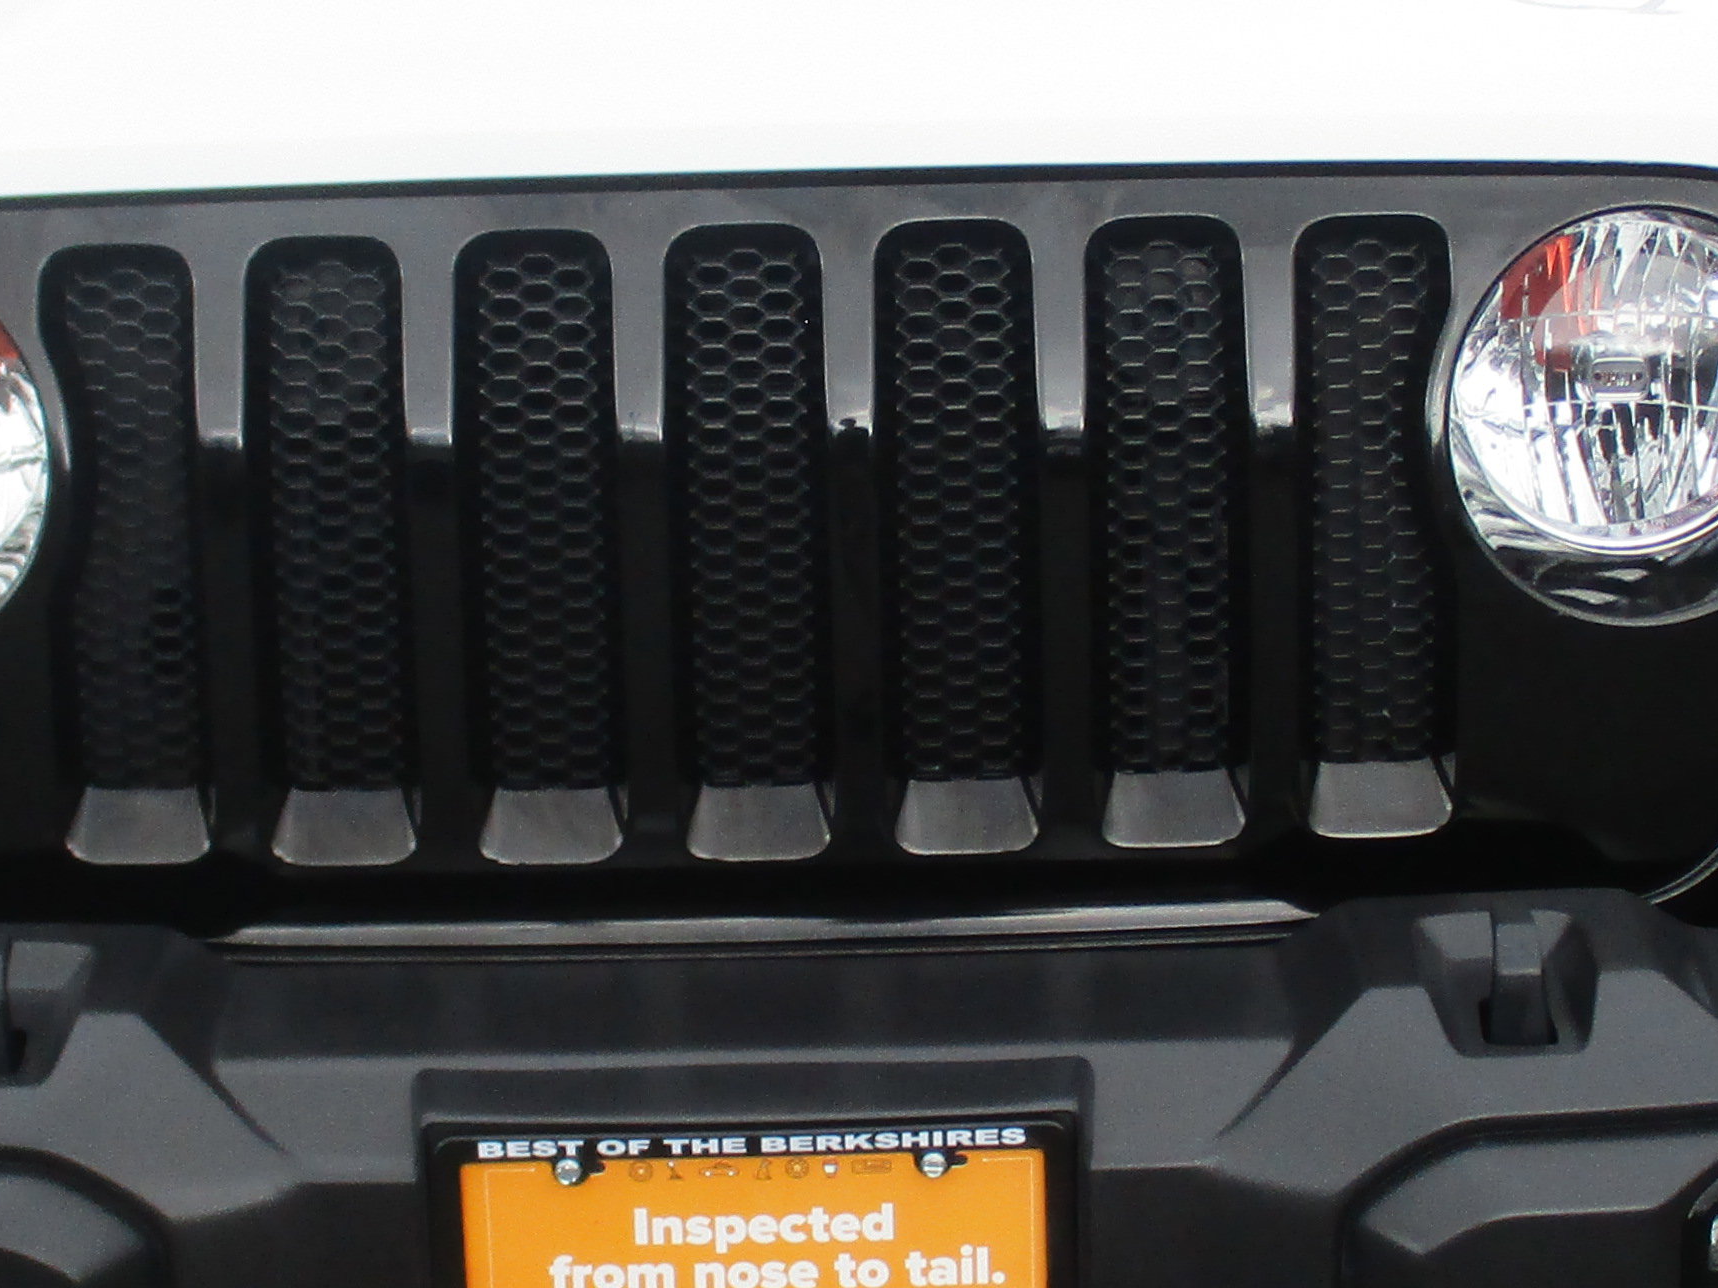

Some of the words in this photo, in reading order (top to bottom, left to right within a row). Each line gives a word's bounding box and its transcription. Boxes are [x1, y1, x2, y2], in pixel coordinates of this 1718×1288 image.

[477, 1139, 585, 1160] BEST
[596, 1138, 651, 1157] OF
[663, 1136, 748, 1156] THE
[761, 1127, 1028, 1155] BERKSHIRES
[633, 1202, 895, 1254] Inspected
[834, 1252, 890, 1288] to
[904, 1244, 1007, 1287] tail.
